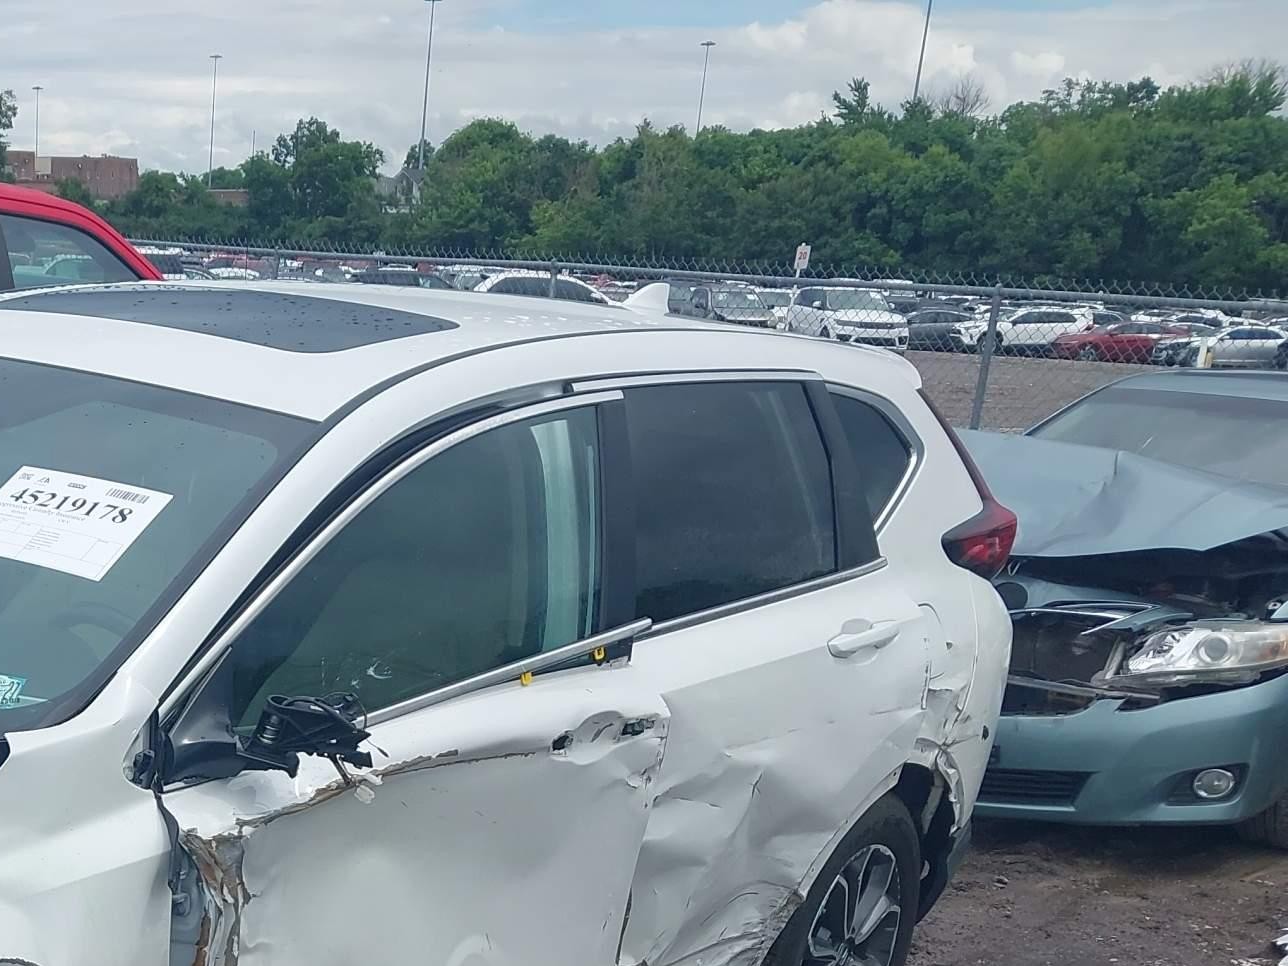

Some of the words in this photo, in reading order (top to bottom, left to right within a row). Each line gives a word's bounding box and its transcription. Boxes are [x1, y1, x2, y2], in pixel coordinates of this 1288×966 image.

[798, 251, 808, 260] 20
[9, 487, 134, 525] 45219178
[2, 680, 22, 702] 27
